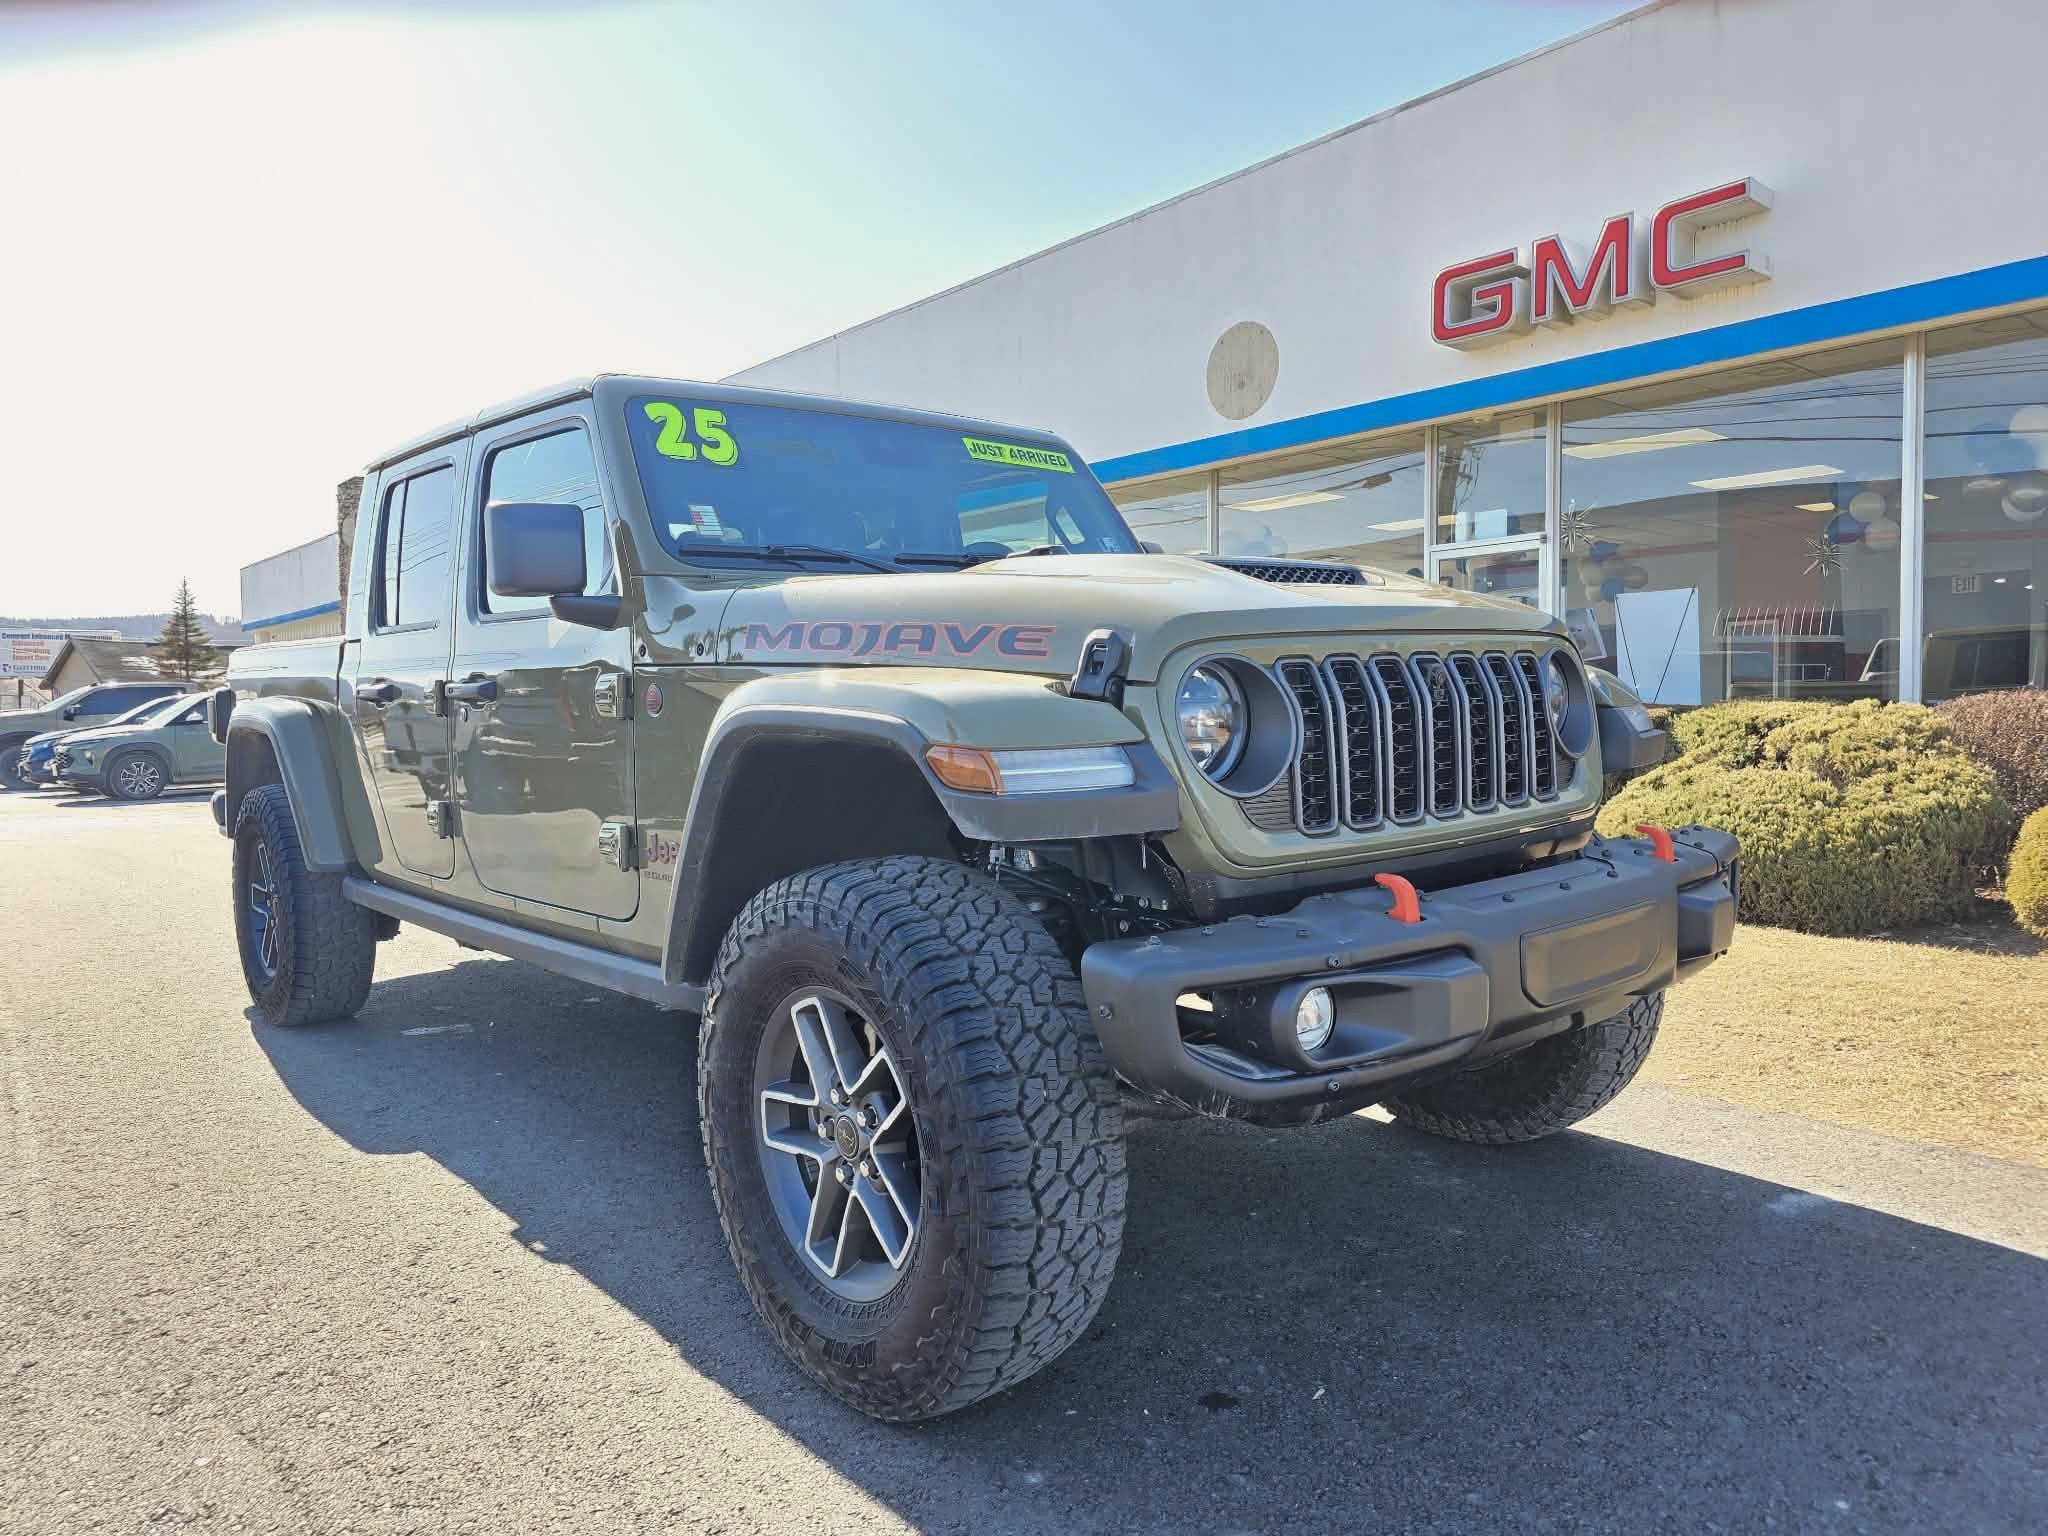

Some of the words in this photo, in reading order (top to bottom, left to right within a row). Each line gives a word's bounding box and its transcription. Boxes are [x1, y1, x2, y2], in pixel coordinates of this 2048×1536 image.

[1431, 176, 1762, 347] GMC
[644, 402, 738, 466] 25
[969, 441, 1004, 458] JUST
[1009, 447, 1067, 467] ARRIVED
[745, 621, 1057, 659] MOJAVE
